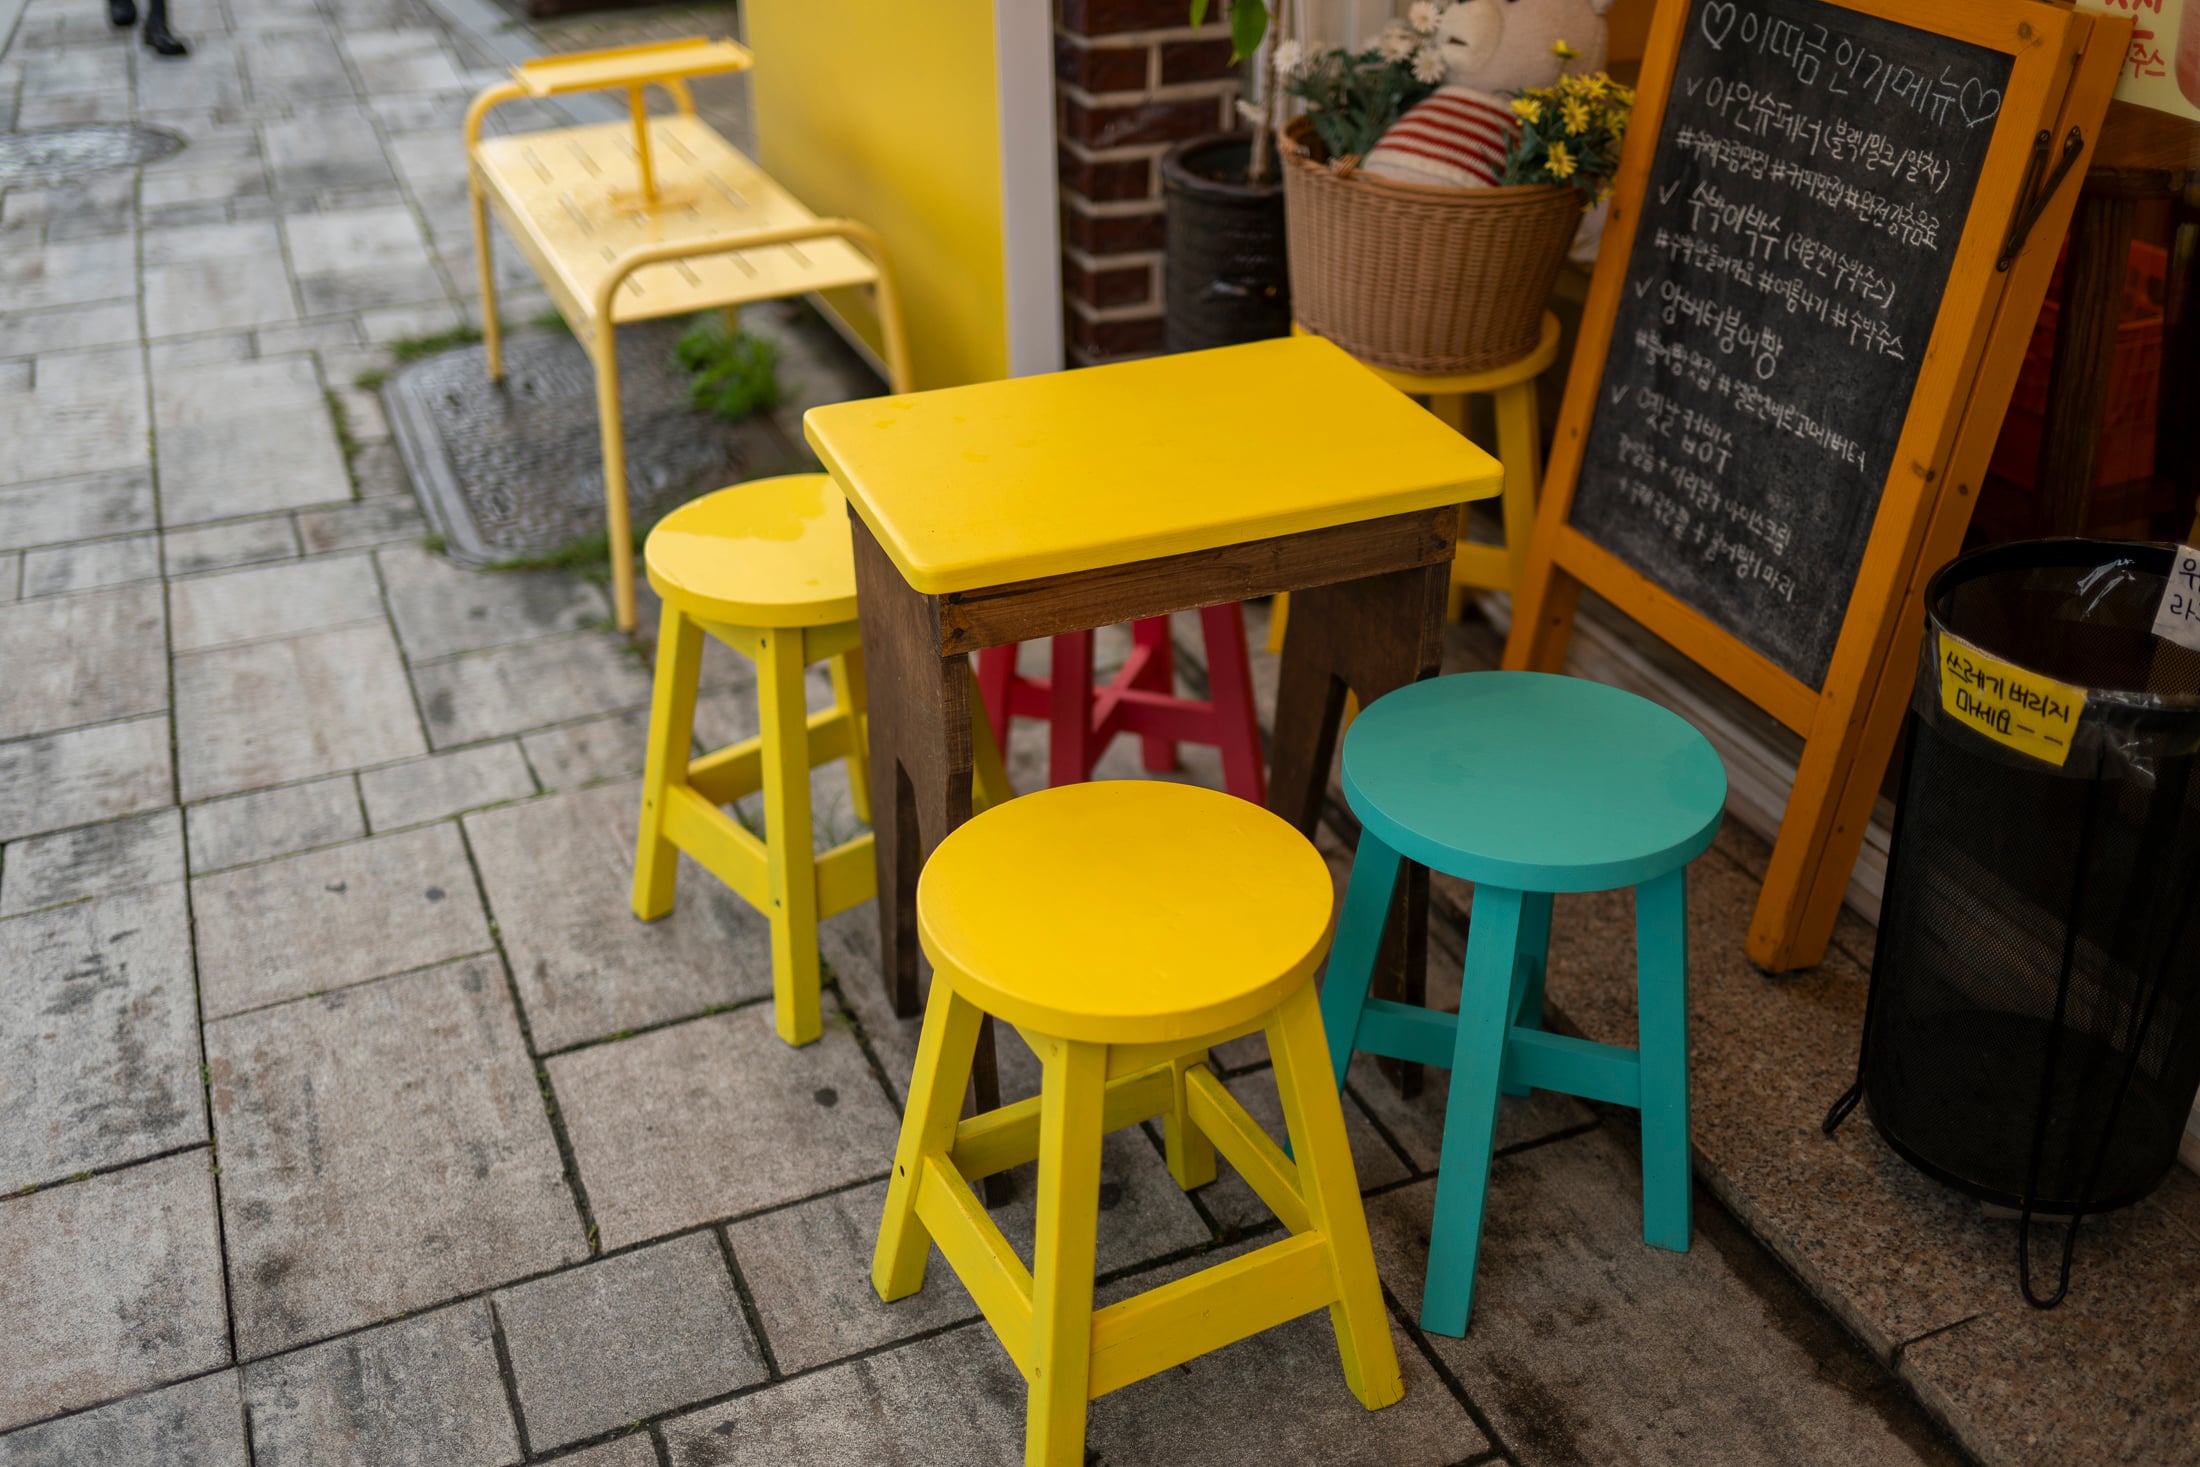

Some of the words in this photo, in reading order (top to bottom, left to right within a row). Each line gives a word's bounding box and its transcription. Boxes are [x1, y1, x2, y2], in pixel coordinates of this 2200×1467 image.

[1740, 12, 1828, 86] 이따금
[1828, 38, 1960, 126] 인기메뉴
[1706, 77, 1822, 155] 아인슈페너
[1688, 180, 1781, 260] 수박이박수
[1661, 280, 1783, 380] 앙버터붕어빵
[1758, 271, 1829, 322] #여름나기
[1831, 303, 1905, 361] #수박주스
[1725, 500, 1791, 556] 아이스크림
[1946, 651, 2004, 700] 쓰레기
[2008, 681, 2070, 724] 버리지
